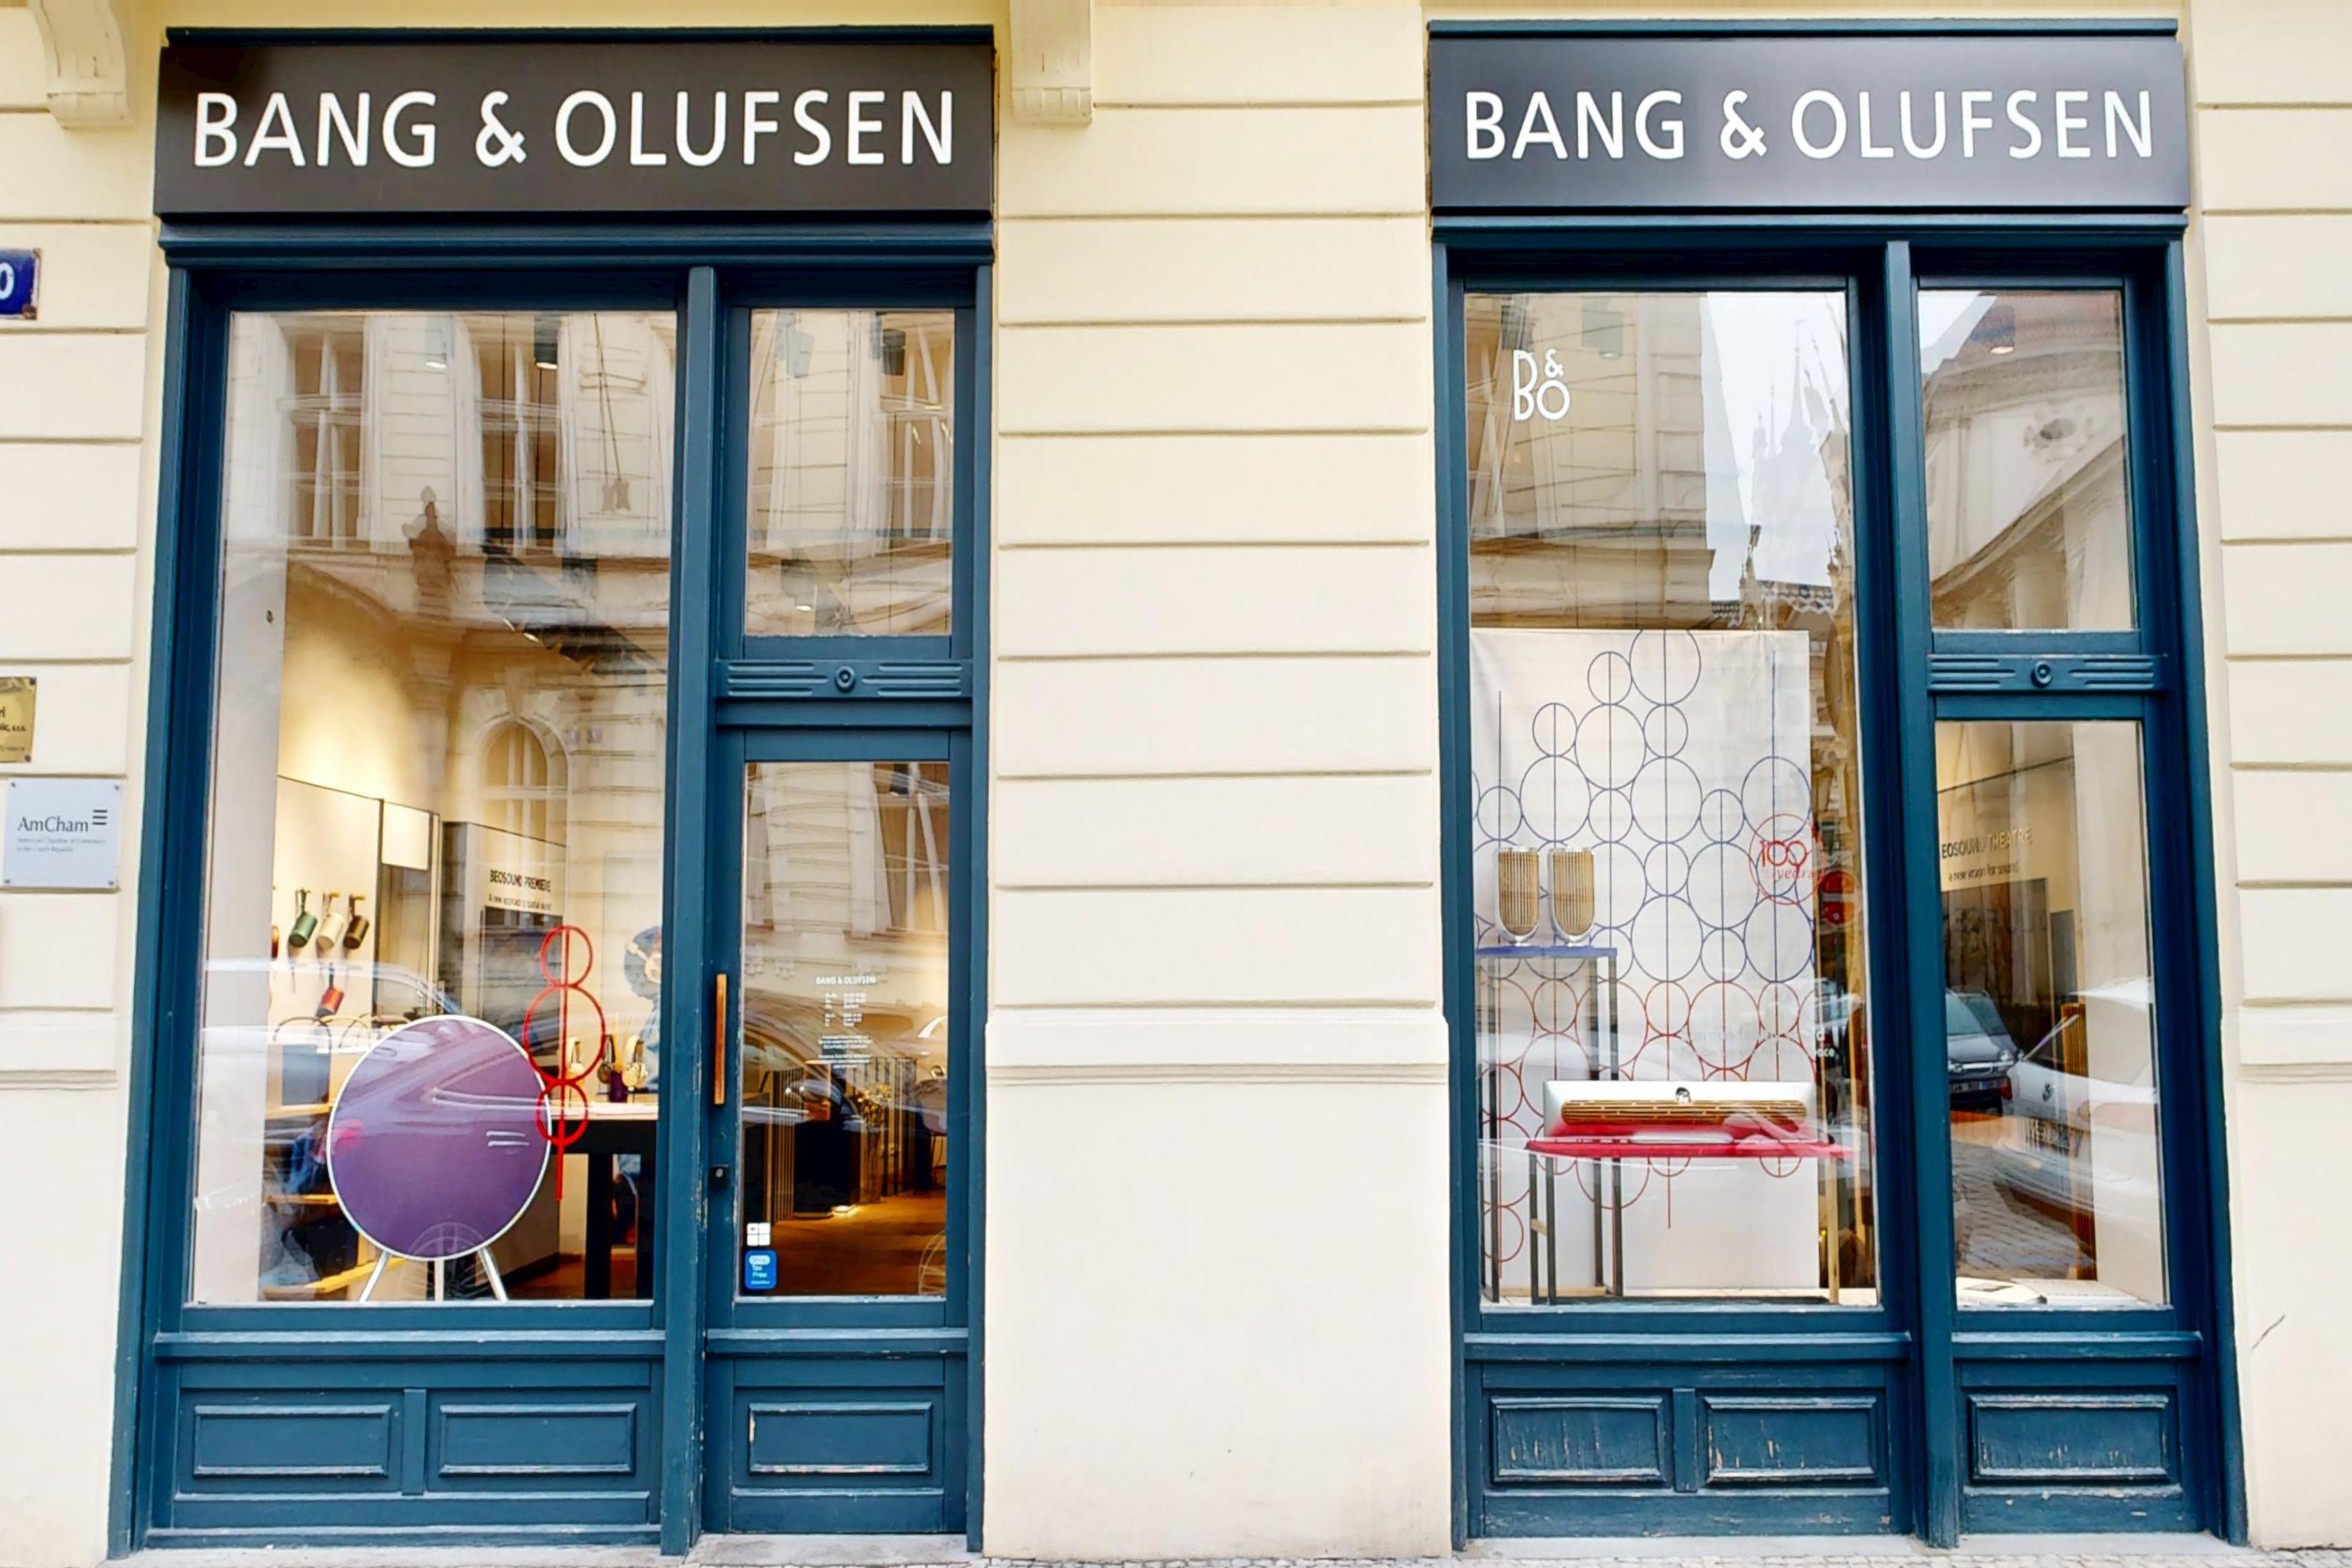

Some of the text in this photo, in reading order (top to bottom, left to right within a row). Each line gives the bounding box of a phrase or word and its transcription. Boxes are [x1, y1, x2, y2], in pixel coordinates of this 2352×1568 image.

[195, 91, 951, 167] BANG & OLUFSEN
[1466, 89, 2152, 160] BANG & OLUFSEN
[17, 816, 89, 832] AmCham
